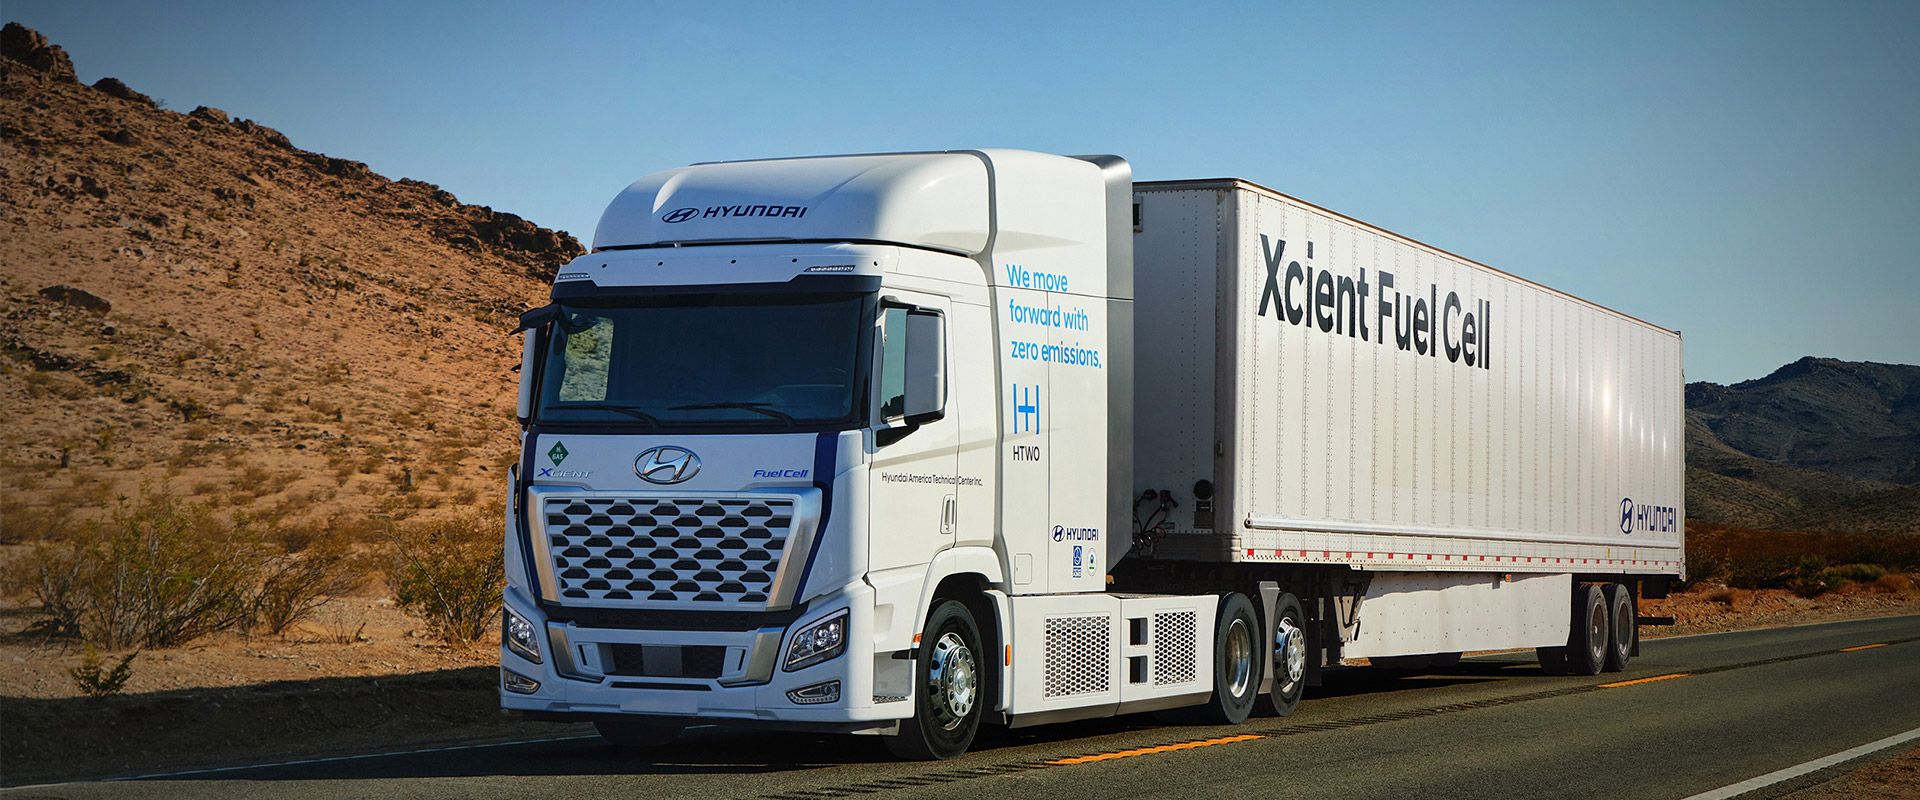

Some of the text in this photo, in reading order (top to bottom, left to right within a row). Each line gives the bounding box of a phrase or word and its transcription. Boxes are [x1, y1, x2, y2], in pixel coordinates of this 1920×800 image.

[703, 205, 808, 219] HYUNDAI
[1006, 264, 1068, 292] We move
[1257, 233, 1491, 370] Xcient Fuel Cell
[1009, 298, 1089, 332] forward with
[1011, 340, 1102, 369] zero emissions.
[1013, 445, 1040, 462] HTWO
[753, 469, 809, 478] Fuel Cell
[881, 472, 908, 484] Hyundai
[908, 473, 932, 484] America
[932, 474, 957, 485] Technical
[958, 475, 974, 486] Center
[1637, 504, 1677, 533] HYUNDAI
[1066, 527, 1099, 541] HYUNDAI
